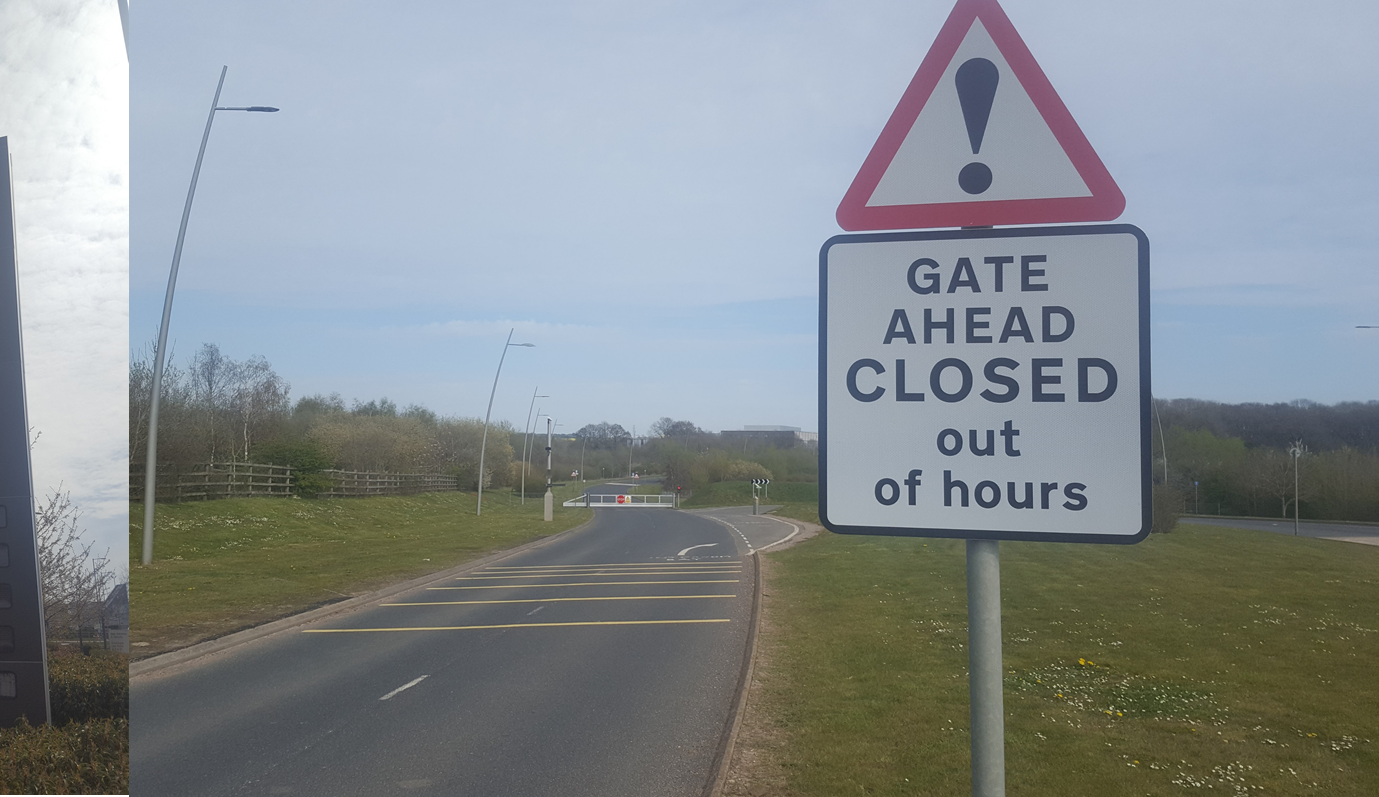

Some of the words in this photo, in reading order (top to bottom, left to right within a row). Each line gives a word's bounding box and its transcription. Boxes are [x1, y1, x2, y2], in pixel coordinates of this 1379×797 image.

[906, 254, 1049, 296] GATE
[882, 305, 1076, 345] AHEAD
[845, 357, 1119, 404] CLOSED
[936, 419, 1021, 457] out
[874, 469, 923, 506] of
[943, 469, 1088, 512] hours
